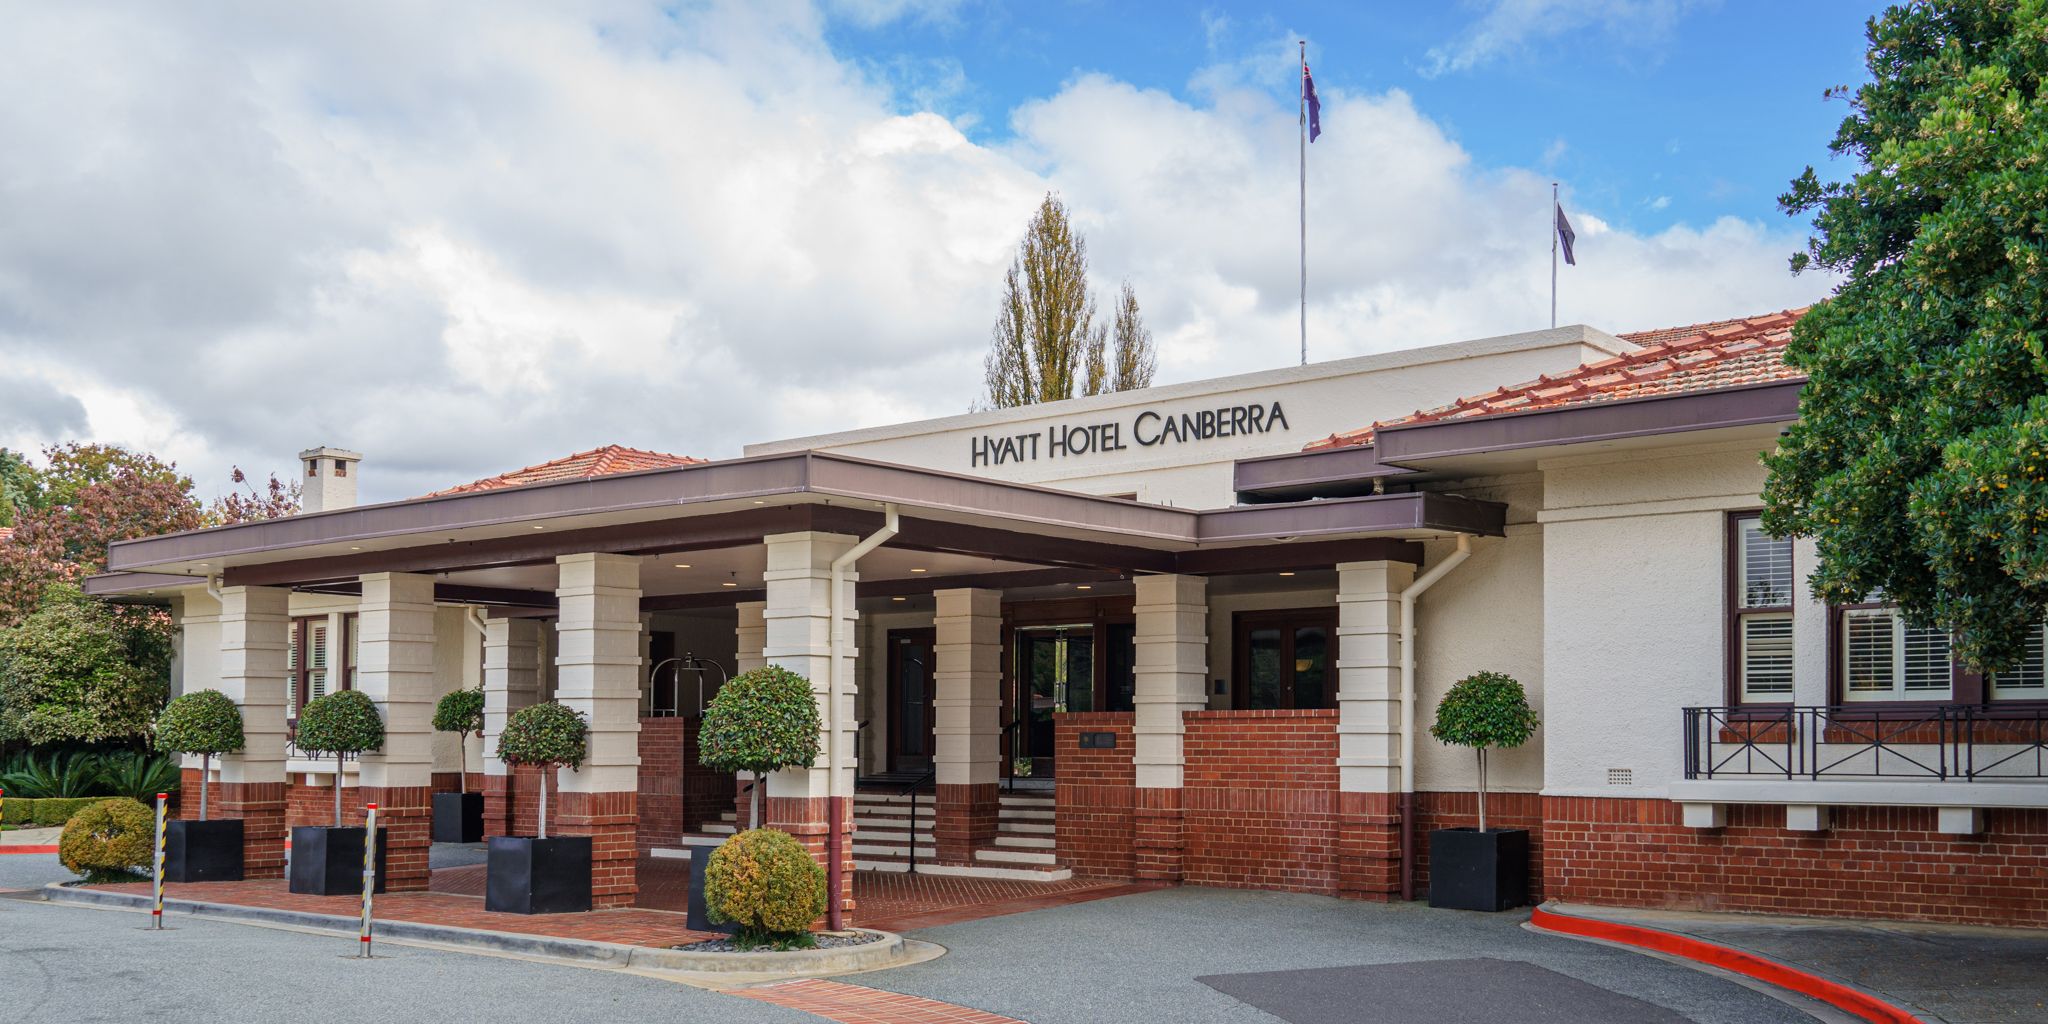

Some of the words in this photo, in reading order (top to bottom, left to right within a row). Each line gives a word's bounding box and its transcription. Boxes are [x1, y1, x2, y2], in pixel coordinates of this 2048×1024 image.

[971, 433, 1041, 467] HYATT
[1049, 423, 1127, 458] HOTEL
[1133, 401, 1289, 446] CANBERRA
